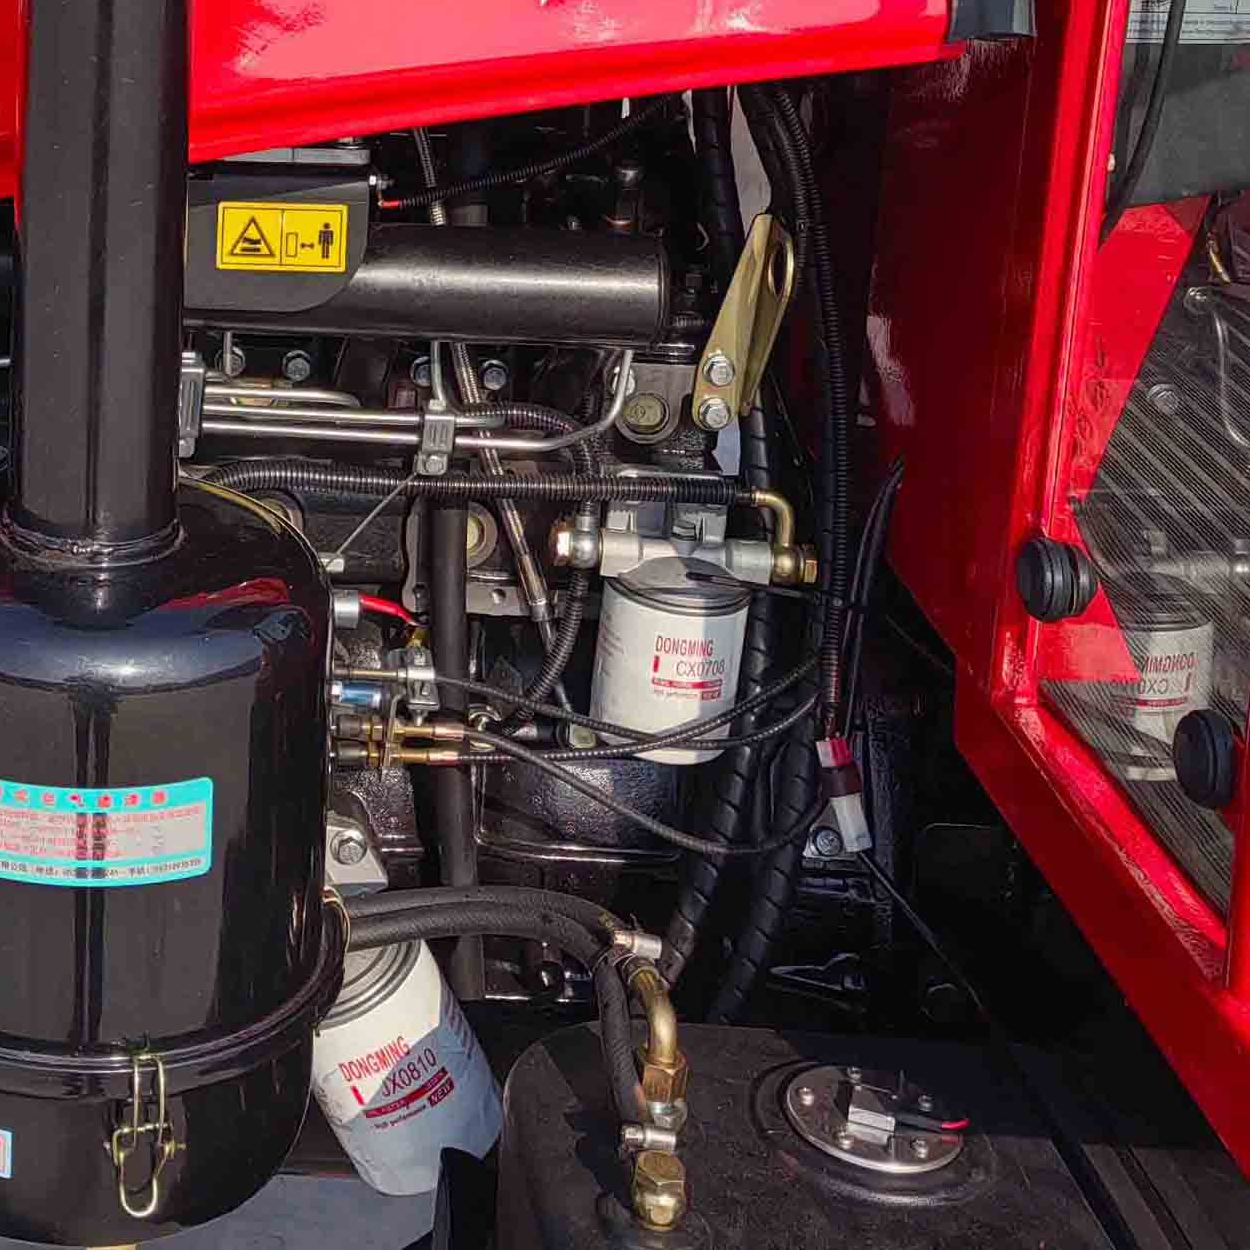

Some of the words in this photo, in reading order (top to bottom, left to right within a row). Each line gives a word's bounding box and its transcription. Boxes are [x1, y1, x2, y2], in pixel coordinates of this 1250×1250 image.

[655, 635, 714, 657] DONGMING
[338, 1036, 411, 1082] DONGMING
[381, 1047, 437, 1098] JX0810
